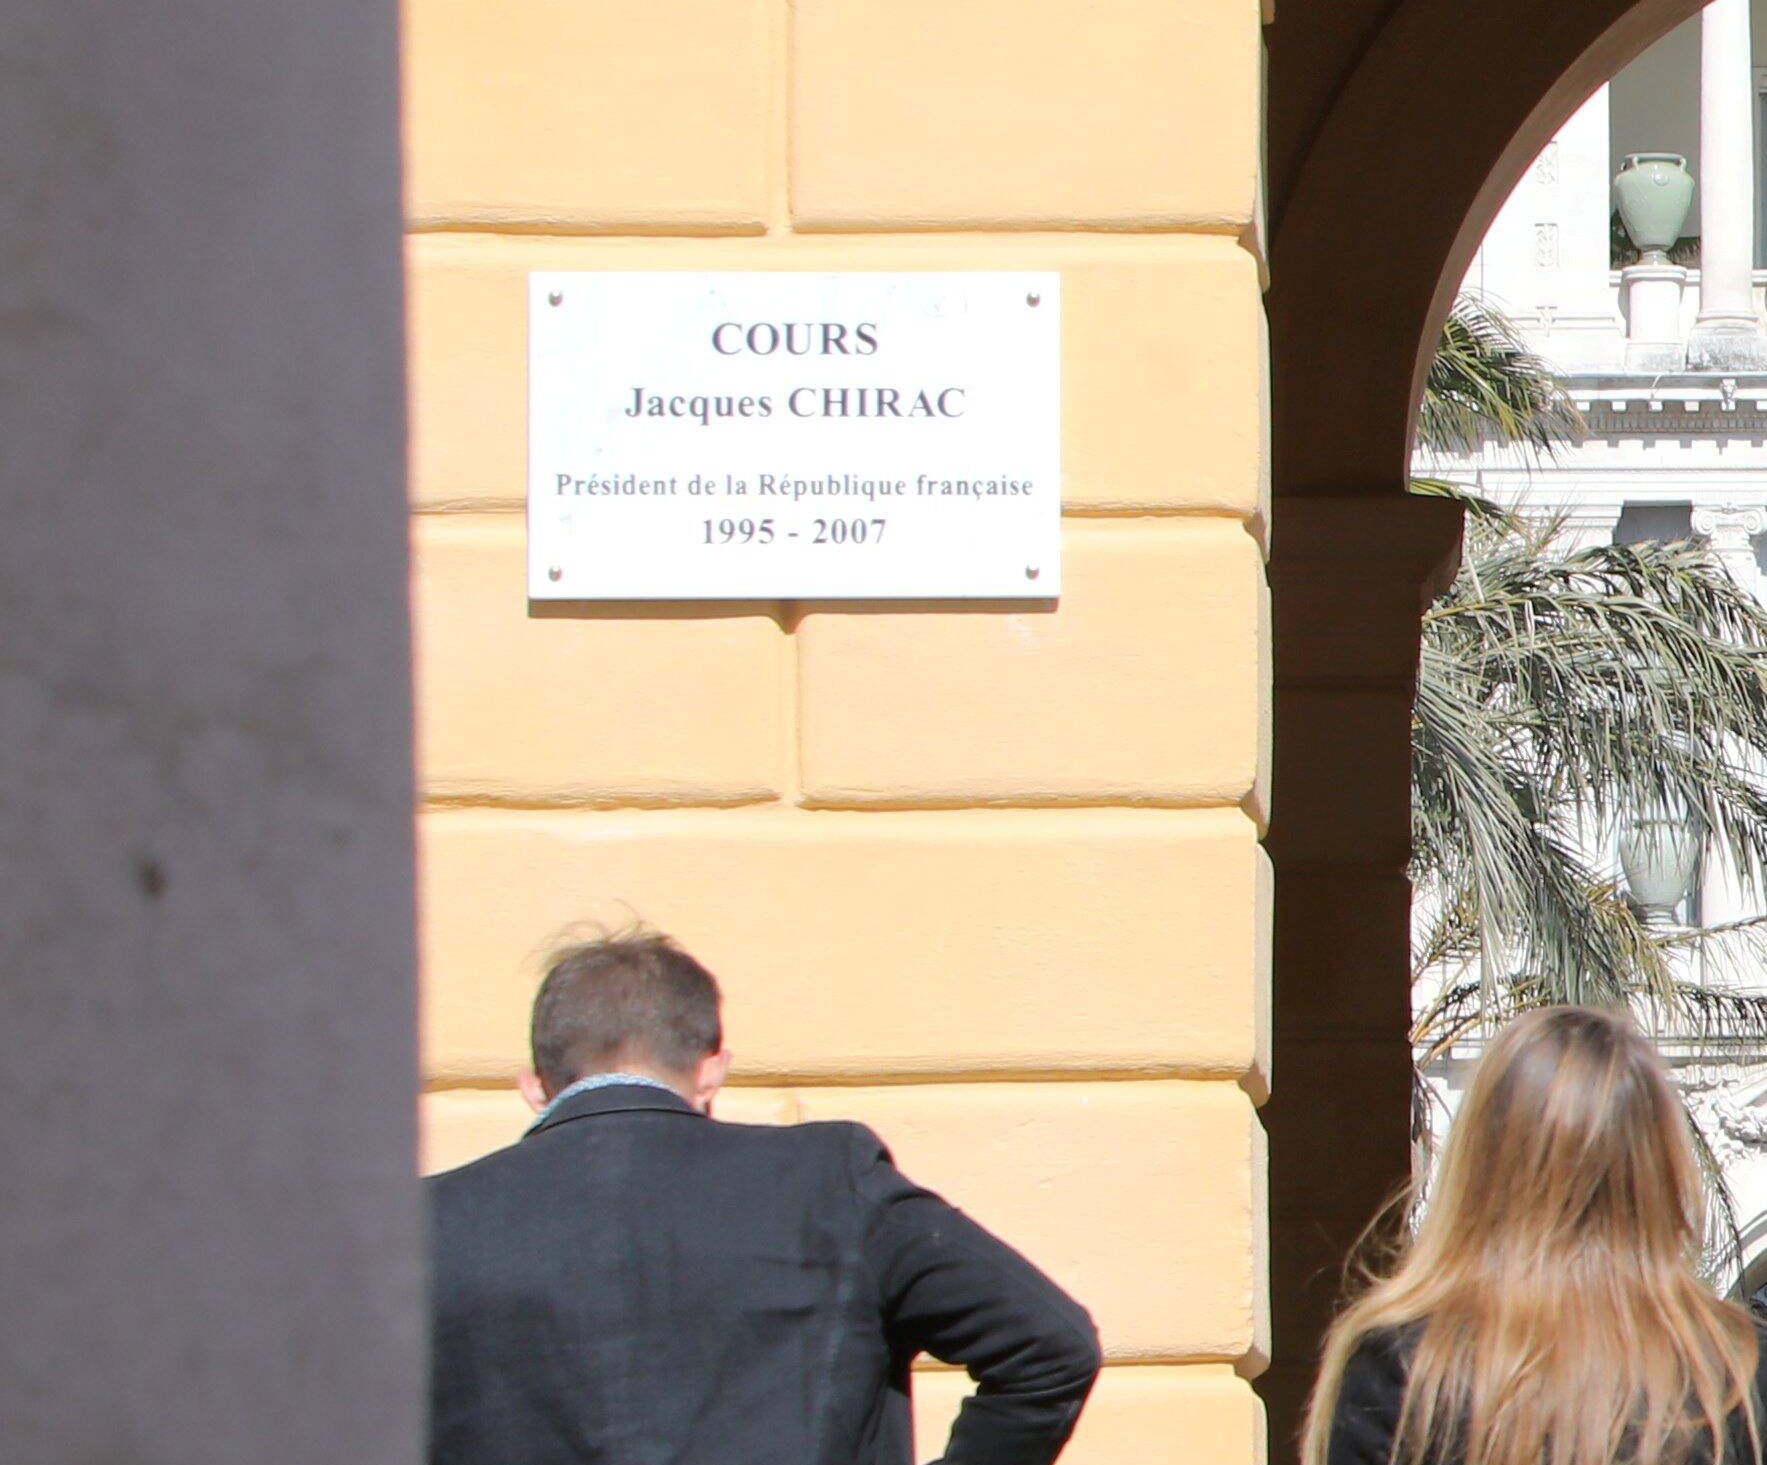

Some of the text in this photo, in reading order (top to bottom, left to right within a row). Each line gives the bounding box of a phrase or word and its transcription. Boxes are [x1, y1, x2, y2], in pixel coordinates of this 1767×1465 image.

[711, 322, 878, 356] COURS
[624, 387, 965, 427] Jacques CHIRAC
[556, 473, 1033, 502] Président de la République française
[703, 518, 775, 545] 1995
[812, 518, 887, 545] 2007
